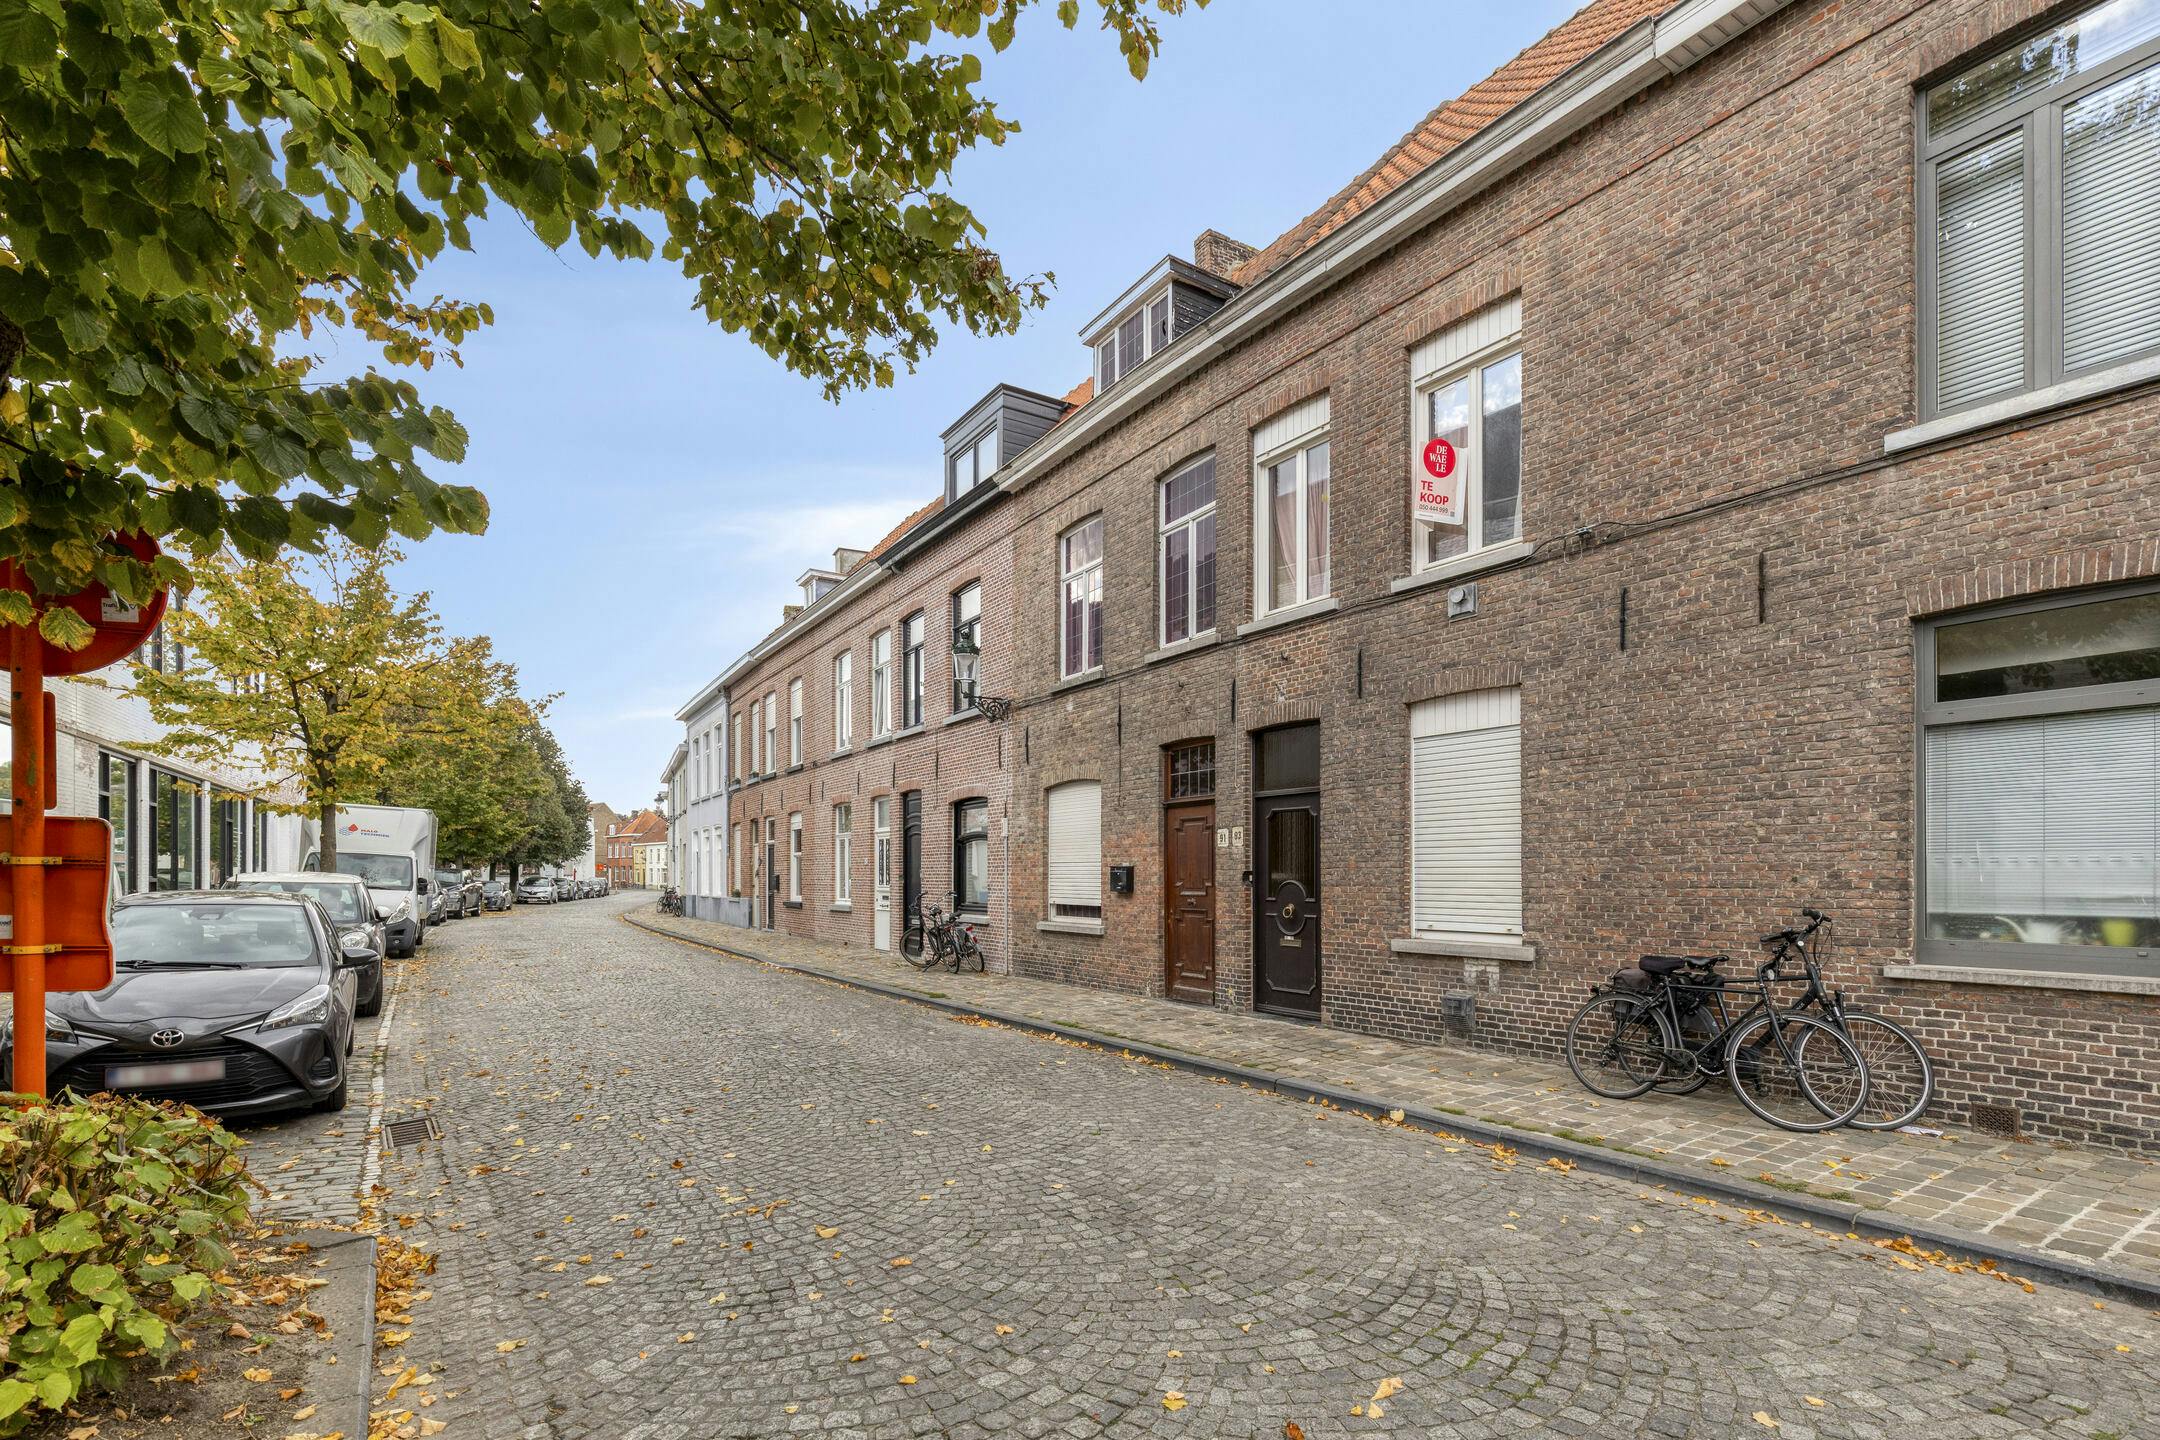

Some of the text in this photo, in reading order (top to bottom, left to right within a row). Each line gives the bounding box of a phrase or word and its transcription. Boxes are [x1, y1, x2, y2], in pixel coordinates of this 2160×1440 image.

[1436, 445, 1447, 454] DE
[1429, 453, 1447, 463] WAE
[1436, 464, 1447, 473] LE
[1421, 480, 1433, 491] TE
[1420, 492, 1449, 505] KOOP
